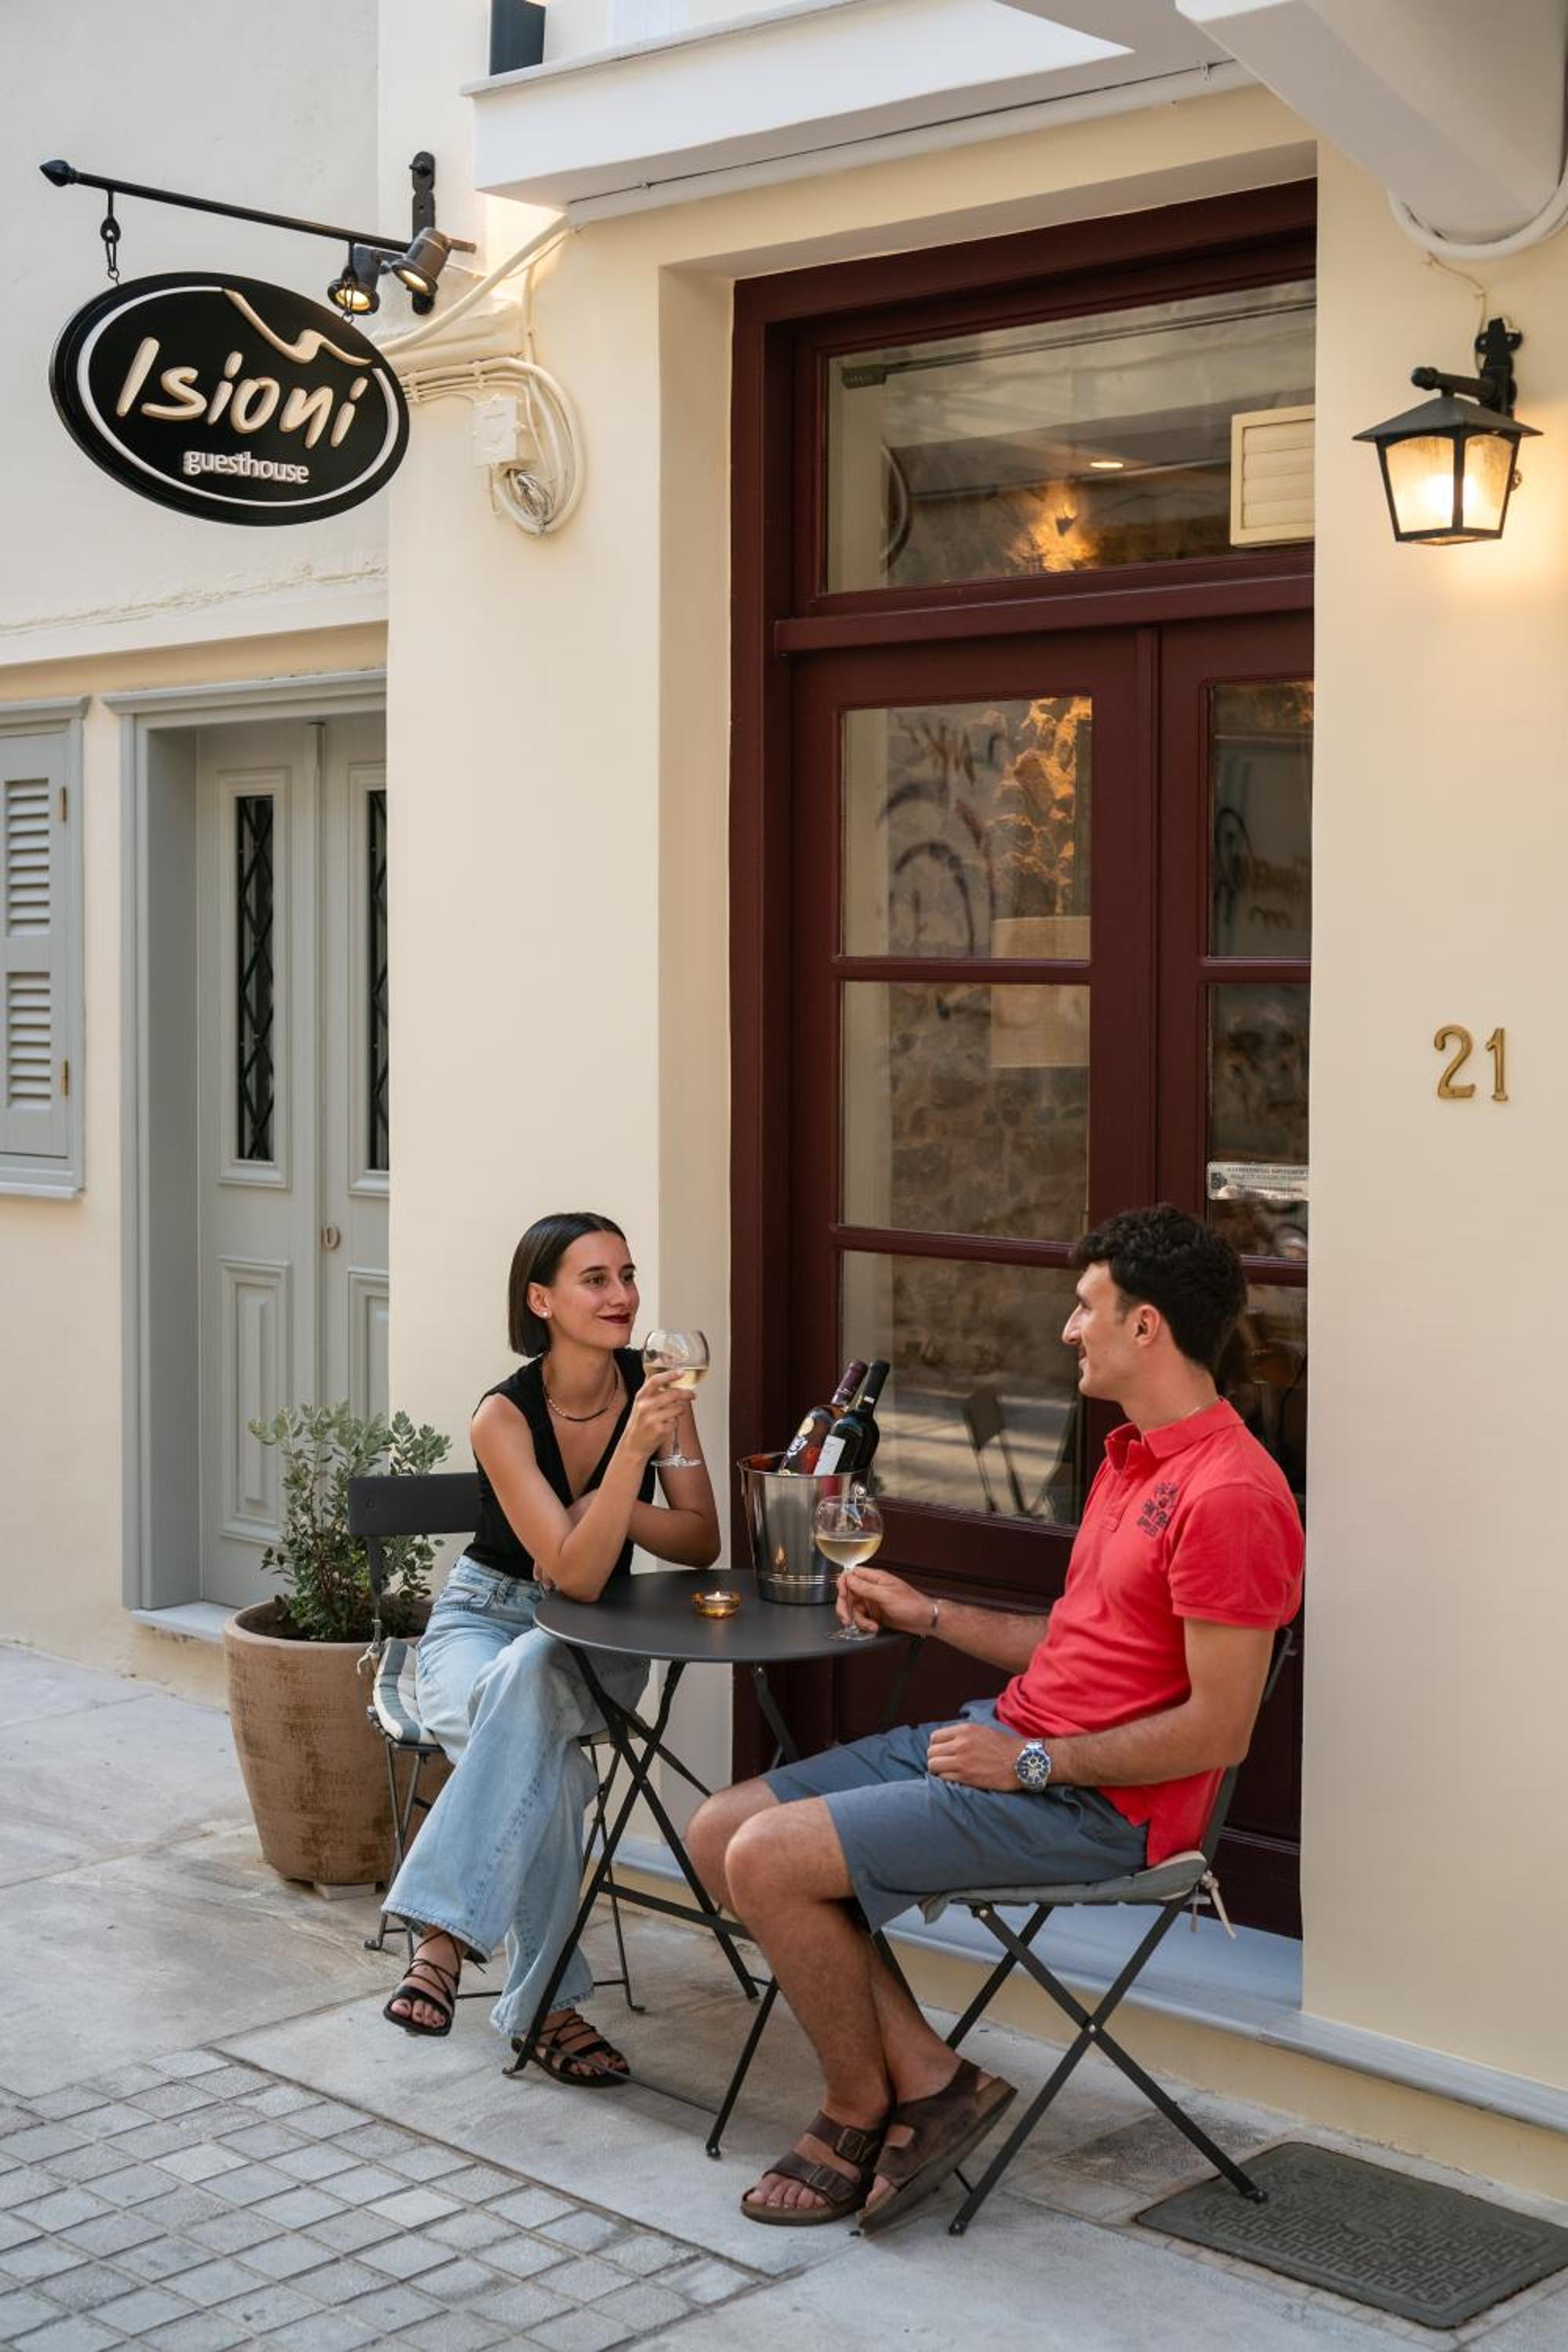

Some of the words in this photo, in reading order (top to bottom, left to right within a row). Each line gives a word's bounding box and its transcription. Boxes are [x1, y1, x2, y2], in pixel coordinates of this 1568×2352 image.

[116, 336, 368, 449] Isioni
[183, 450, 310, 484] guesthouse
[1434, 1024, 1508, 1102] 21
